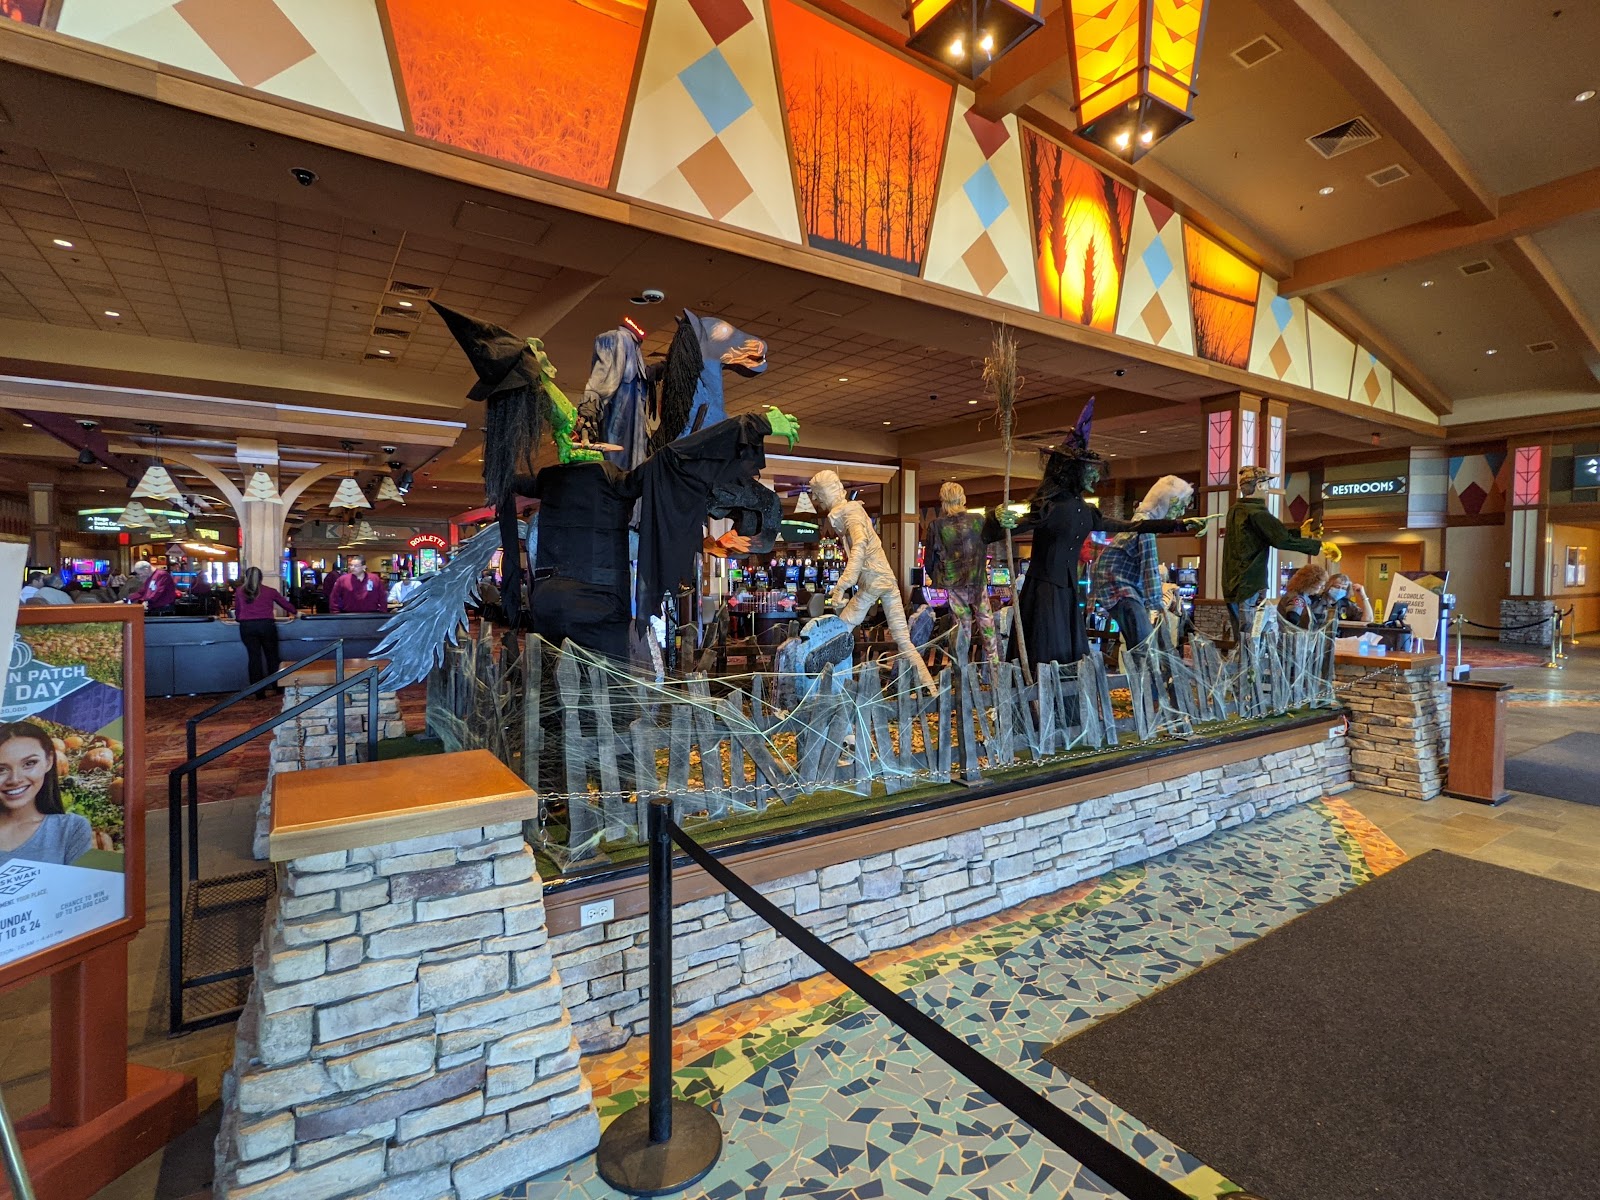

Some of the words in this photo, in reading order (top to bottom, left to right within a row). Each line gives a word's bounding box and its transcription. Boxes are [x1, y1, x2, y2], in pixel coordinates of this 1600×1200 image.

[1332, 481, 1394, 495] RESTROOMS
[409, 535, 446, 547] ROULETTE
[28, 665, 86, 682] PATCH
[15, 680, 65, 701] DAY
[55, 911, 64, 919] UP
[94, 895, 109, 905] CASH
[60, 897, 84, 910] CHANCE
[93, 890, 105, 898] WIN
[6, 927, 17, 939] 10
[20, 925, 27, 935] &
[29, 919, 42, 931] 24
